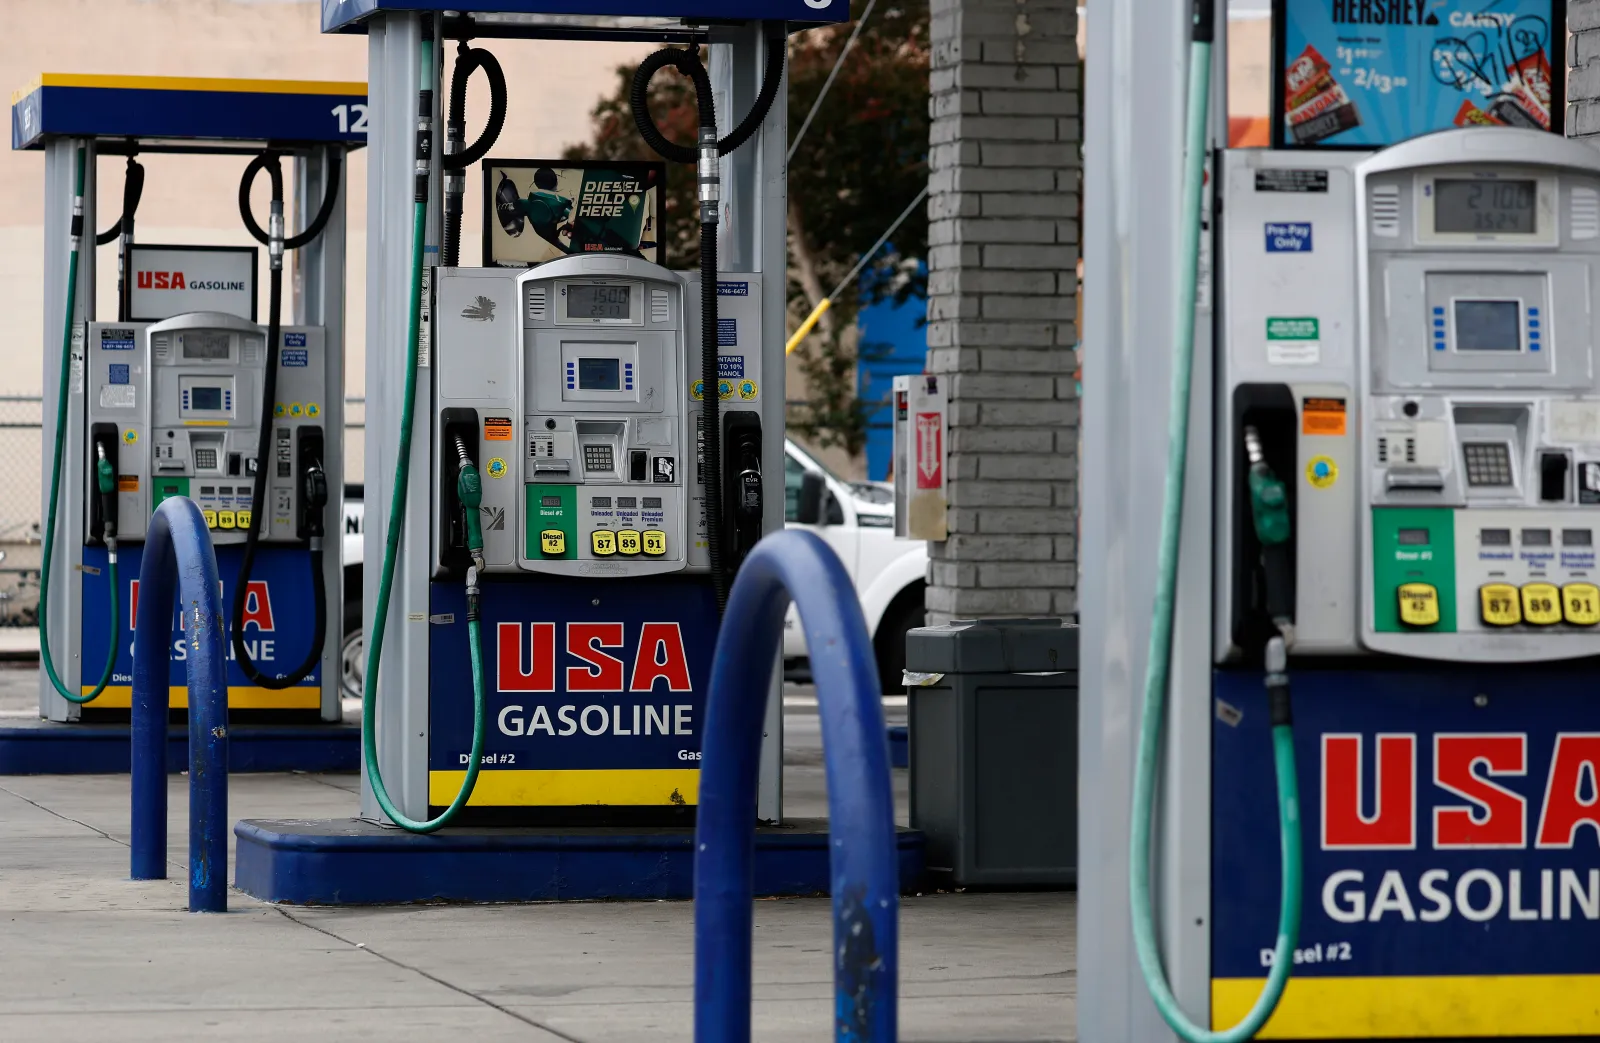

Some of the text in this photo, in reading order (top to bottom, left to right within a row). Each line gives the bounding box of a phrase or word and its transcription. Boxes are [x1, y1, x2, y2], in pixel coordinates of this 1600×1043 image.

[1449, 11, 1516, 28] CANDY
[331, 104, 368, 133] 12
[584, 181, 644, 193] DIESEL
[581, 193, 626, 205] SOLD
[578, 205, 625, 217] HERE
[1267, 224, 1310, 239] Pre-Pay
[1274, 236, 1303, 251] Only
[137, 271, 245, 292] USA GASOLINE
[240, 516, 250, 524] 91
[597, 540, 611, 549] 87
[622, 539, 637, 548] 89
[647, 539, 662, 549] 91
[1490, 598, 1512, 613] 87
[1530, 598, 1552, 613] 89
[1571, 598, 1592, 613] 91
[497, 622, 692, 692] USA
[497, 705, 692, 736] GASOLINE
[459, 753, 516, 764] Disel #2
[1321, 732, 1600, 850] USA
[1260, 942, 1353, 967] Dsel #2
